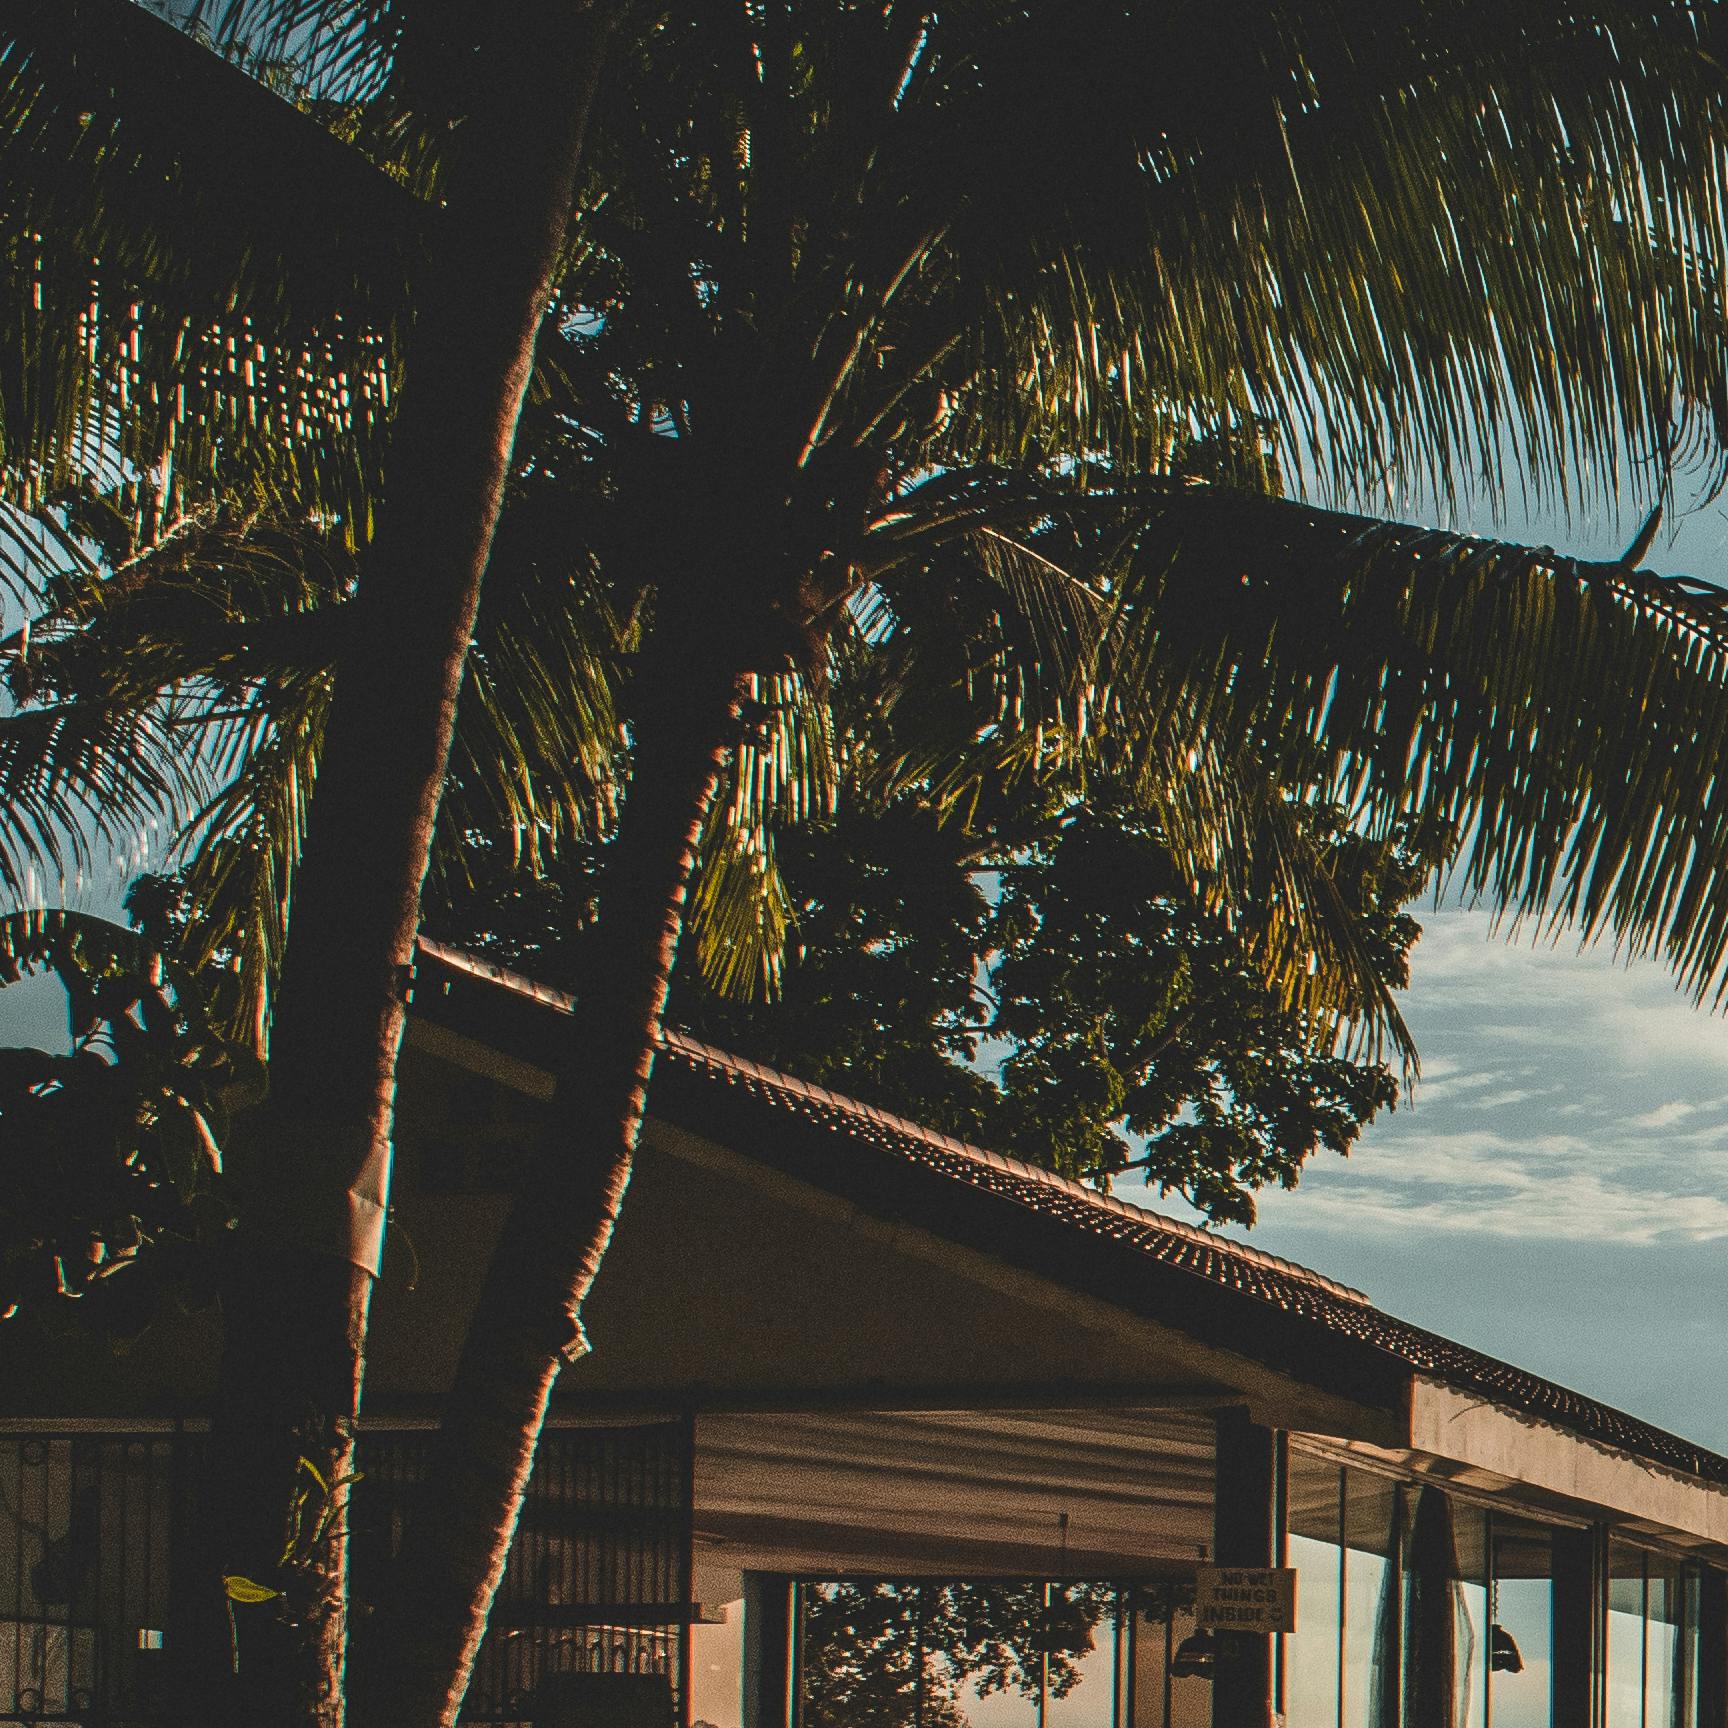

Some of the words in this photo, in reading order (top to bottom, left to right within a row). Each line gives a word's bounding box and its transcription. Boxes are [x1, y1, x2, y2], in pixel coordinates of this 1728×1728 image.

[1222, 1572, 1243, 1586] NO
[1247, 1572, 1274, 1587] WET
[1213, 1588, 1277, 1603] THINGS
